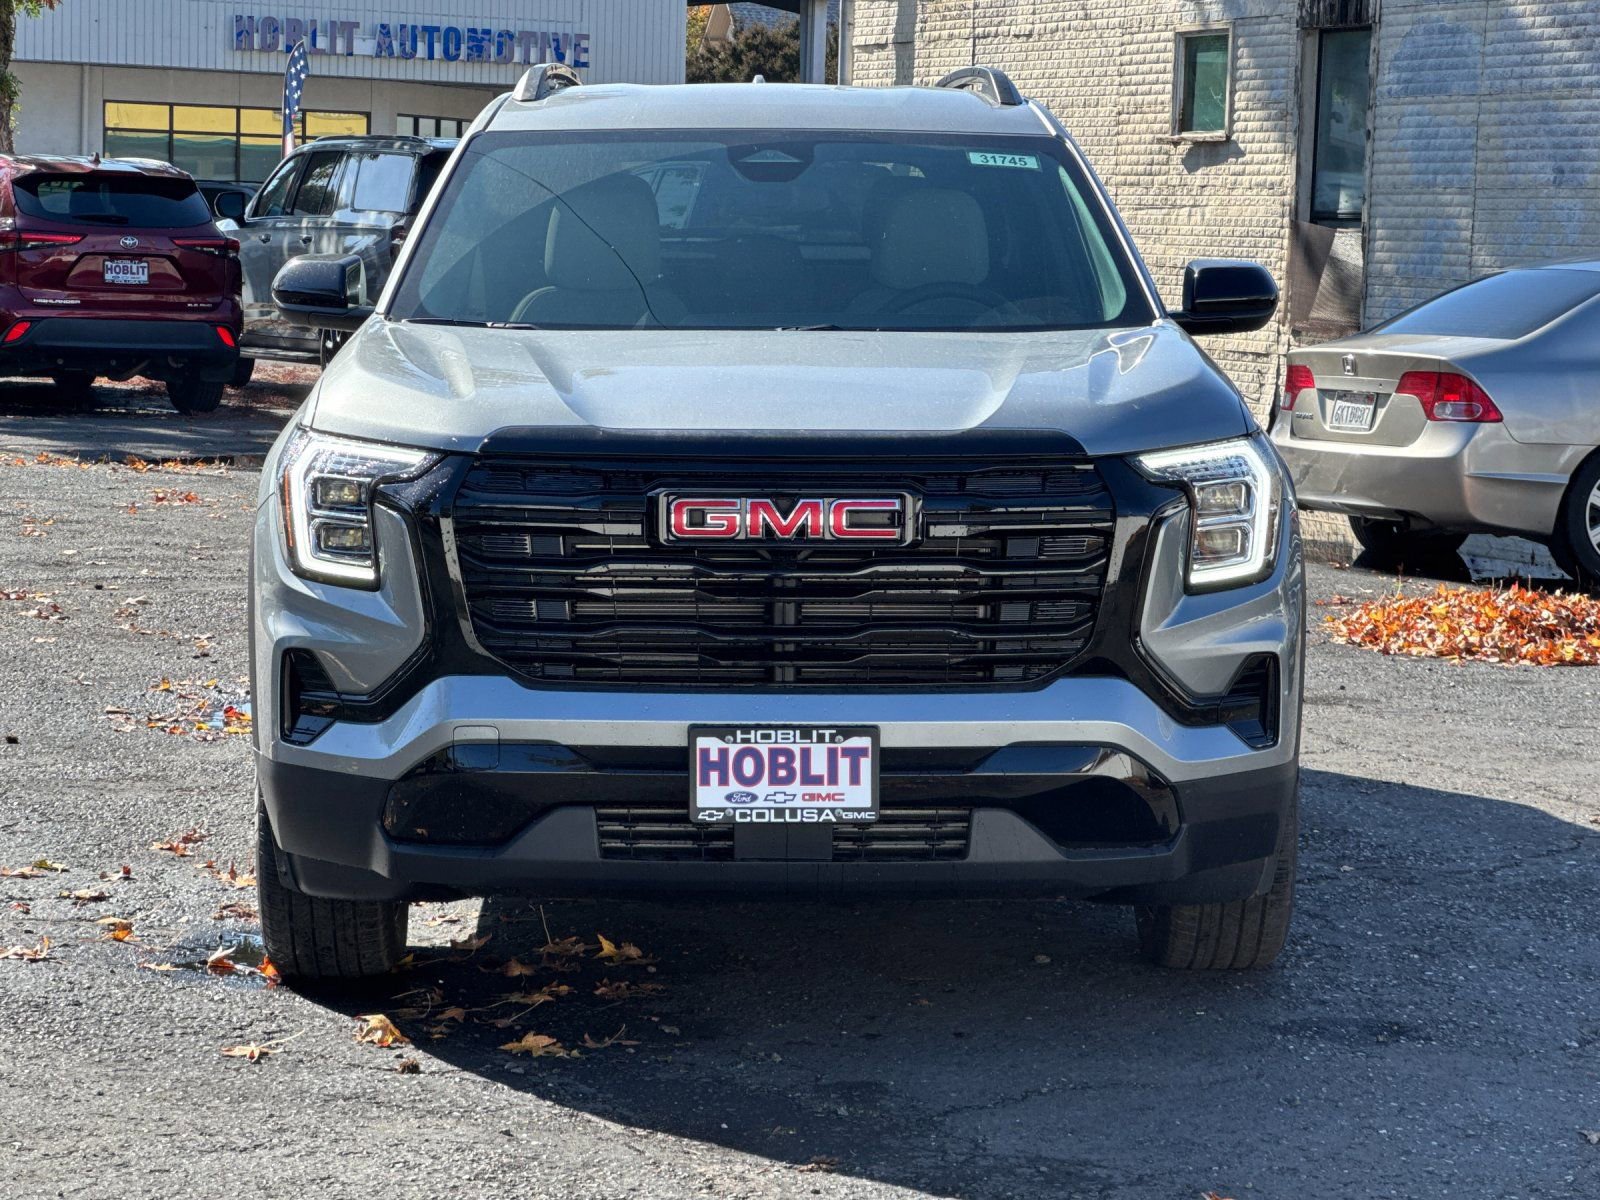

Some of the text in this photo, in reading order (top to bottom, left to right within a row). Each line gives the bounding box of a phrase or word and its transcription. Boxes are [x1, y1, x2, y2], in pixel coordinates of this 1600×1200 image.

[234, 14, 591, 69] HOBLIT AUTOMOTIVE
[979, 154, 1028, 167] 31745
[105, 264, 147, 276] HOBLIT
[670, 498, 900, 540] GMC
[736, 729, 837, 744] HOBLIT
[698, 745, 870, 788] HOBLIT
[801, 792, 845, 802] GMC
[735, 808, 837, 823] COLUSA
[842, 811, 876, 819] GMC
